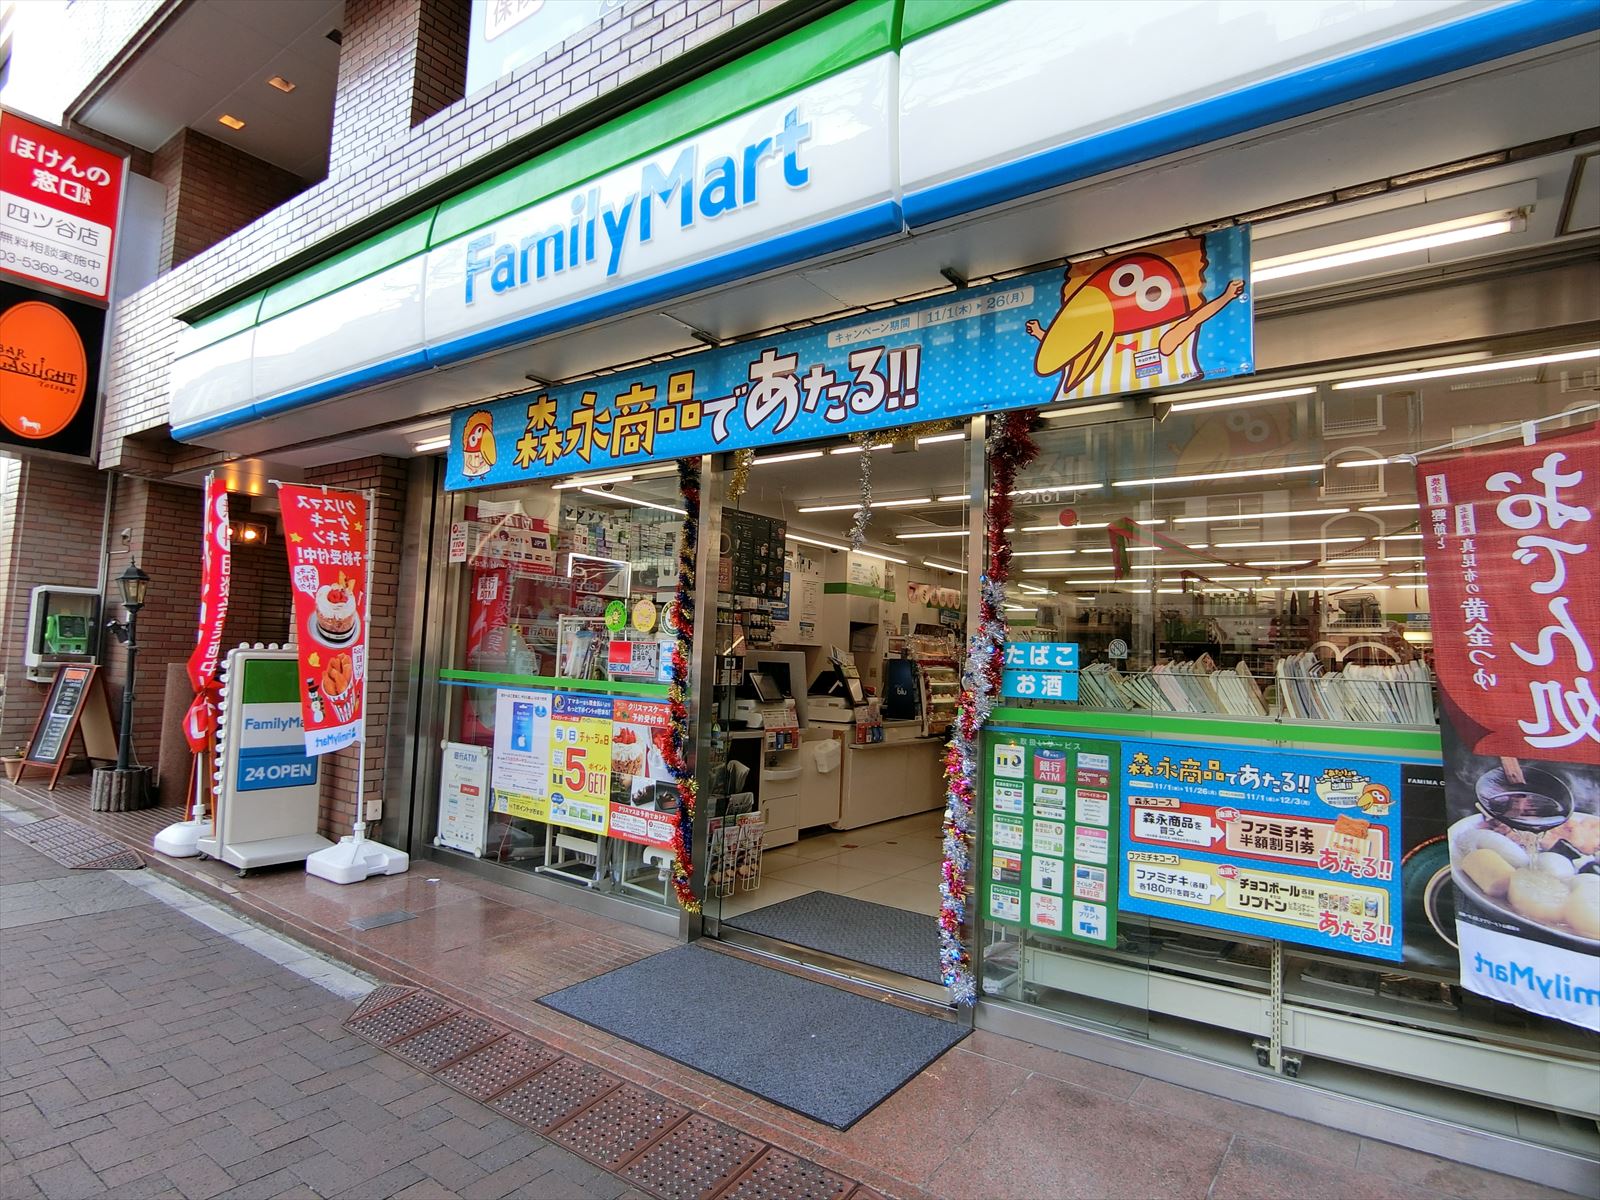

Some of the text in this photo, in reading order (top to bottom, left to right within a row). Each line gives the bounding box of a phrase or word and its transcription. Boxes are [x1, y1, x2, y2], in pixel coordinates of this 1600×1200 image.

[10, 134, 111, 186] ほけんの
[32, 168, 81, 201] 窓口
[465, 105, 812, 306] FamilyMart
[7, 202, 99, 247] 四ツ谷店
[0, 231, 100, 271] 無料相談実施中
[986, 291, 1025, 310] 26(月)
[835, 316, 910, 343] キャンペーン期間
[1007, 645, 1074, 667] たばこ
[609, 663, 630, 672] SECOM
[1016, 674, 1063, 698] お酒
[245, 764, 312, 781] 24 OPEN
[566, 747, 587, 792] 5
[1040, 760, 1061, 772] 銀行
[588, 772, 607, 795] GET!
[1039, 772, 1061, 782] ATM
[1407, 777, 1438, 786] FAMIMA
[1135, 797, 1173, 807] 森永コース
[1143, 812, 1202, 831] 森永商品を
[1160, 826, 1184, 837] 買うと
[1241, 820, 1314, 841] ファミチキ
[1240, 833, 1315, 855] 半額割引券
[1129, 852, 1178, 864] ファミチキコース
[1040, 866, 1056, 874] コピー
[1240, 878, 1301, 897] チョコボール
[1240, 893, 1288, 913] リプトン
